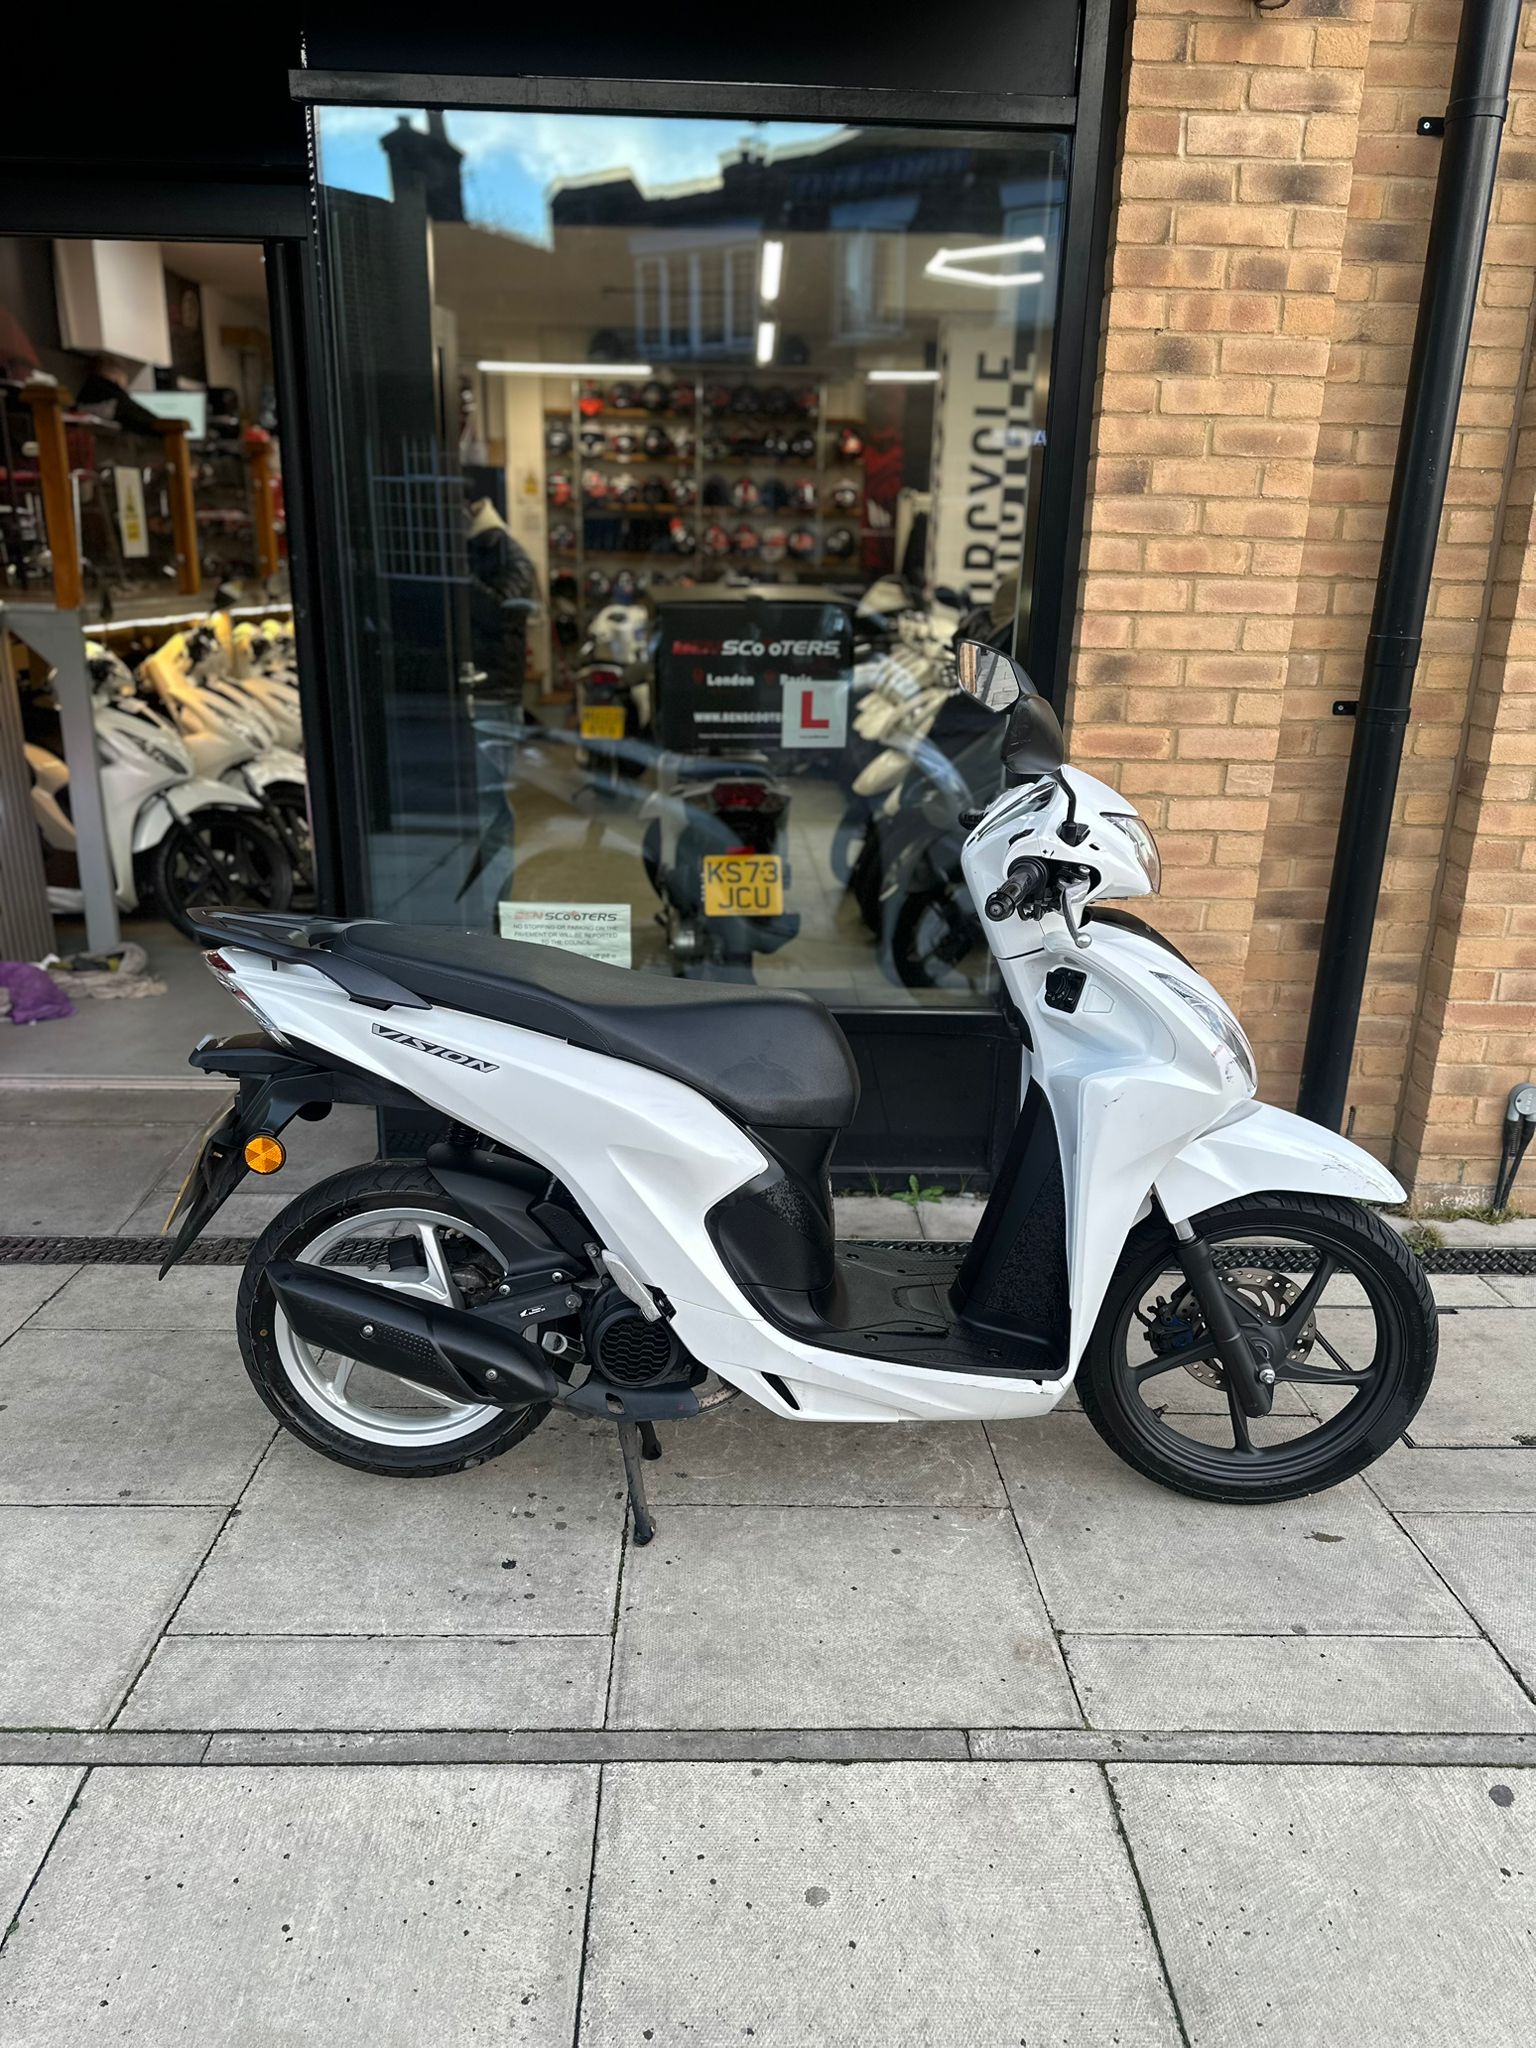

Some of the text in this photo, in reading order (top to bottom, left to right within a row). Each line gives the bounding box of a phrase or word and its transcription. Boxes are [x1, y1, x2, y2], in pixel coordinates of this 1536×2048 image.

[706, 673, 755, 686] London
[800, 691, 830, 728] L
[707, 861, 778, 883] KS73
[719, 887, 771, 909] JCU
[372, 1023, 499, 1073] VISION
